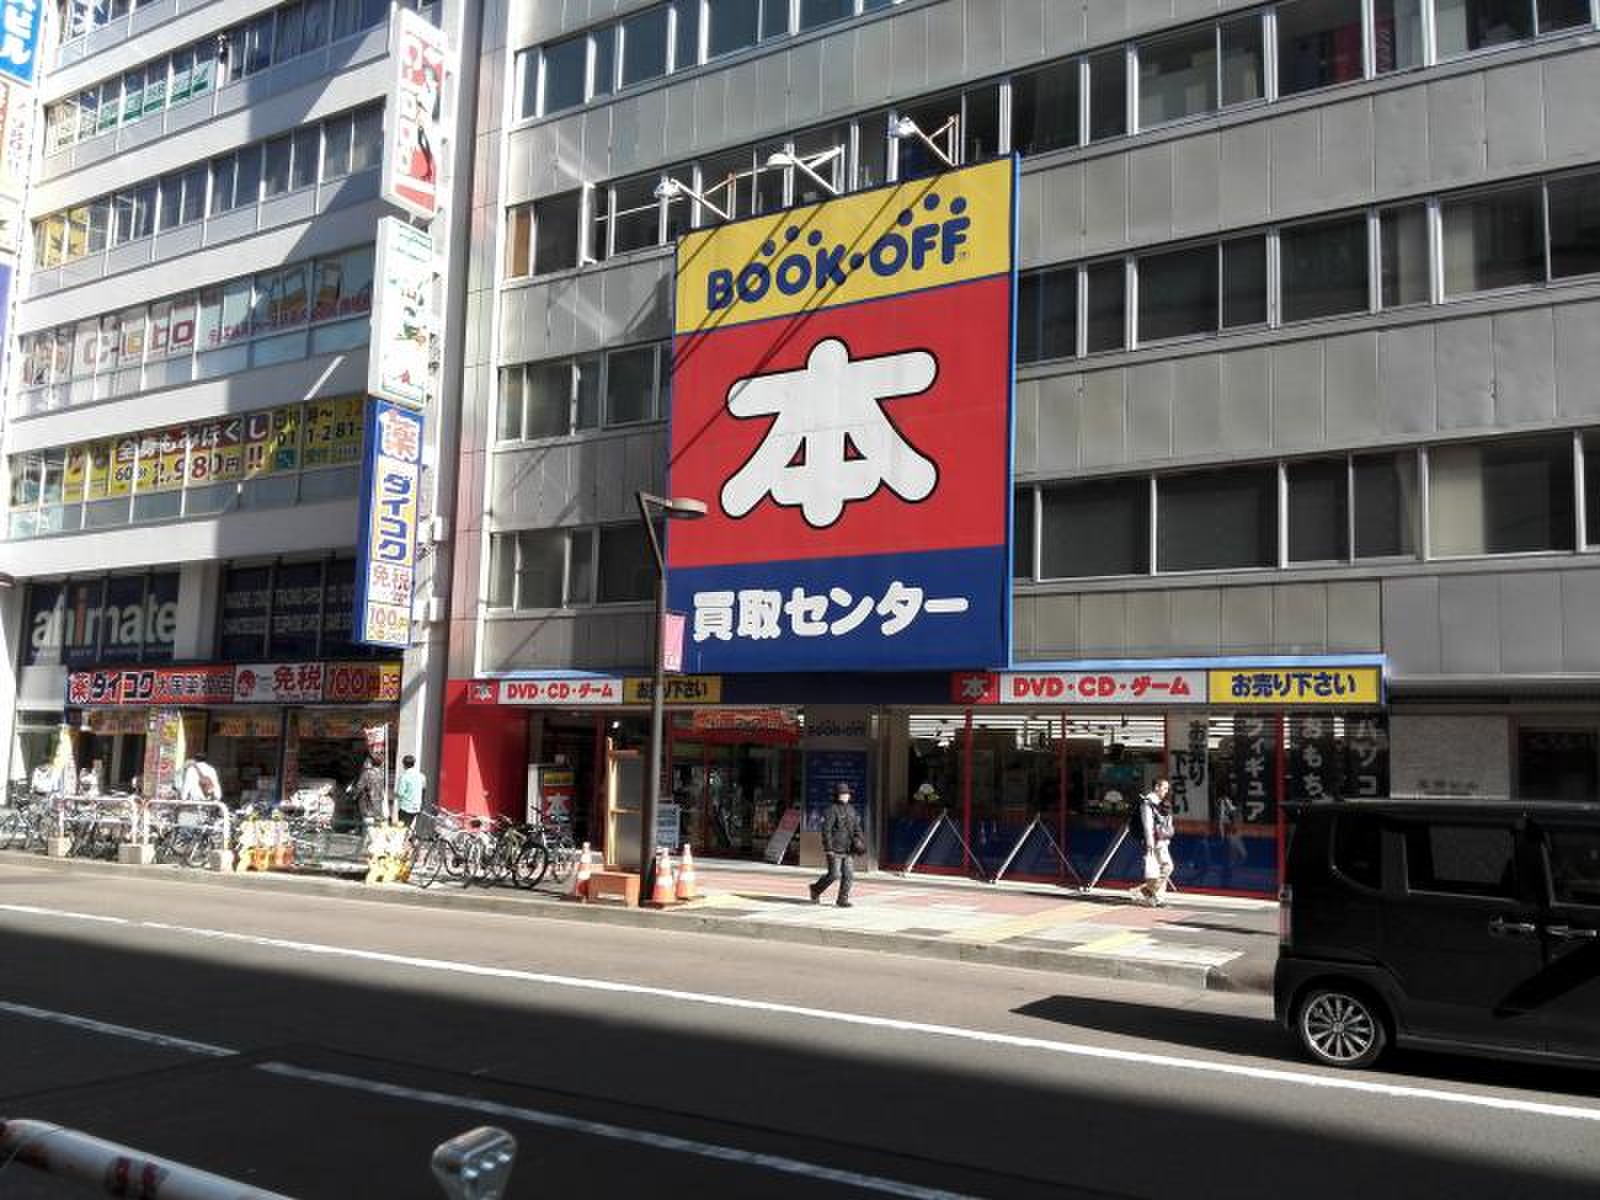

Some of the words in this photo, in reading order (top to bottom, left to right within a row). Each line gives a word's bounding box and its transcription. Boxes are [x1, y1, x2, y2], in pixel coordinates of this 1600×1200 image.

[720, 336, 939, 529] 本
[379, 472, 413, 562] ダイコク
[31, 587, 177, 648] animate
[693, 581, 969, 641] 買取センター
[272, 664, 321, 692] 免税
[961, 676, 989, 699] 本
[1231, 671, 1357, 698] お売り下さい
